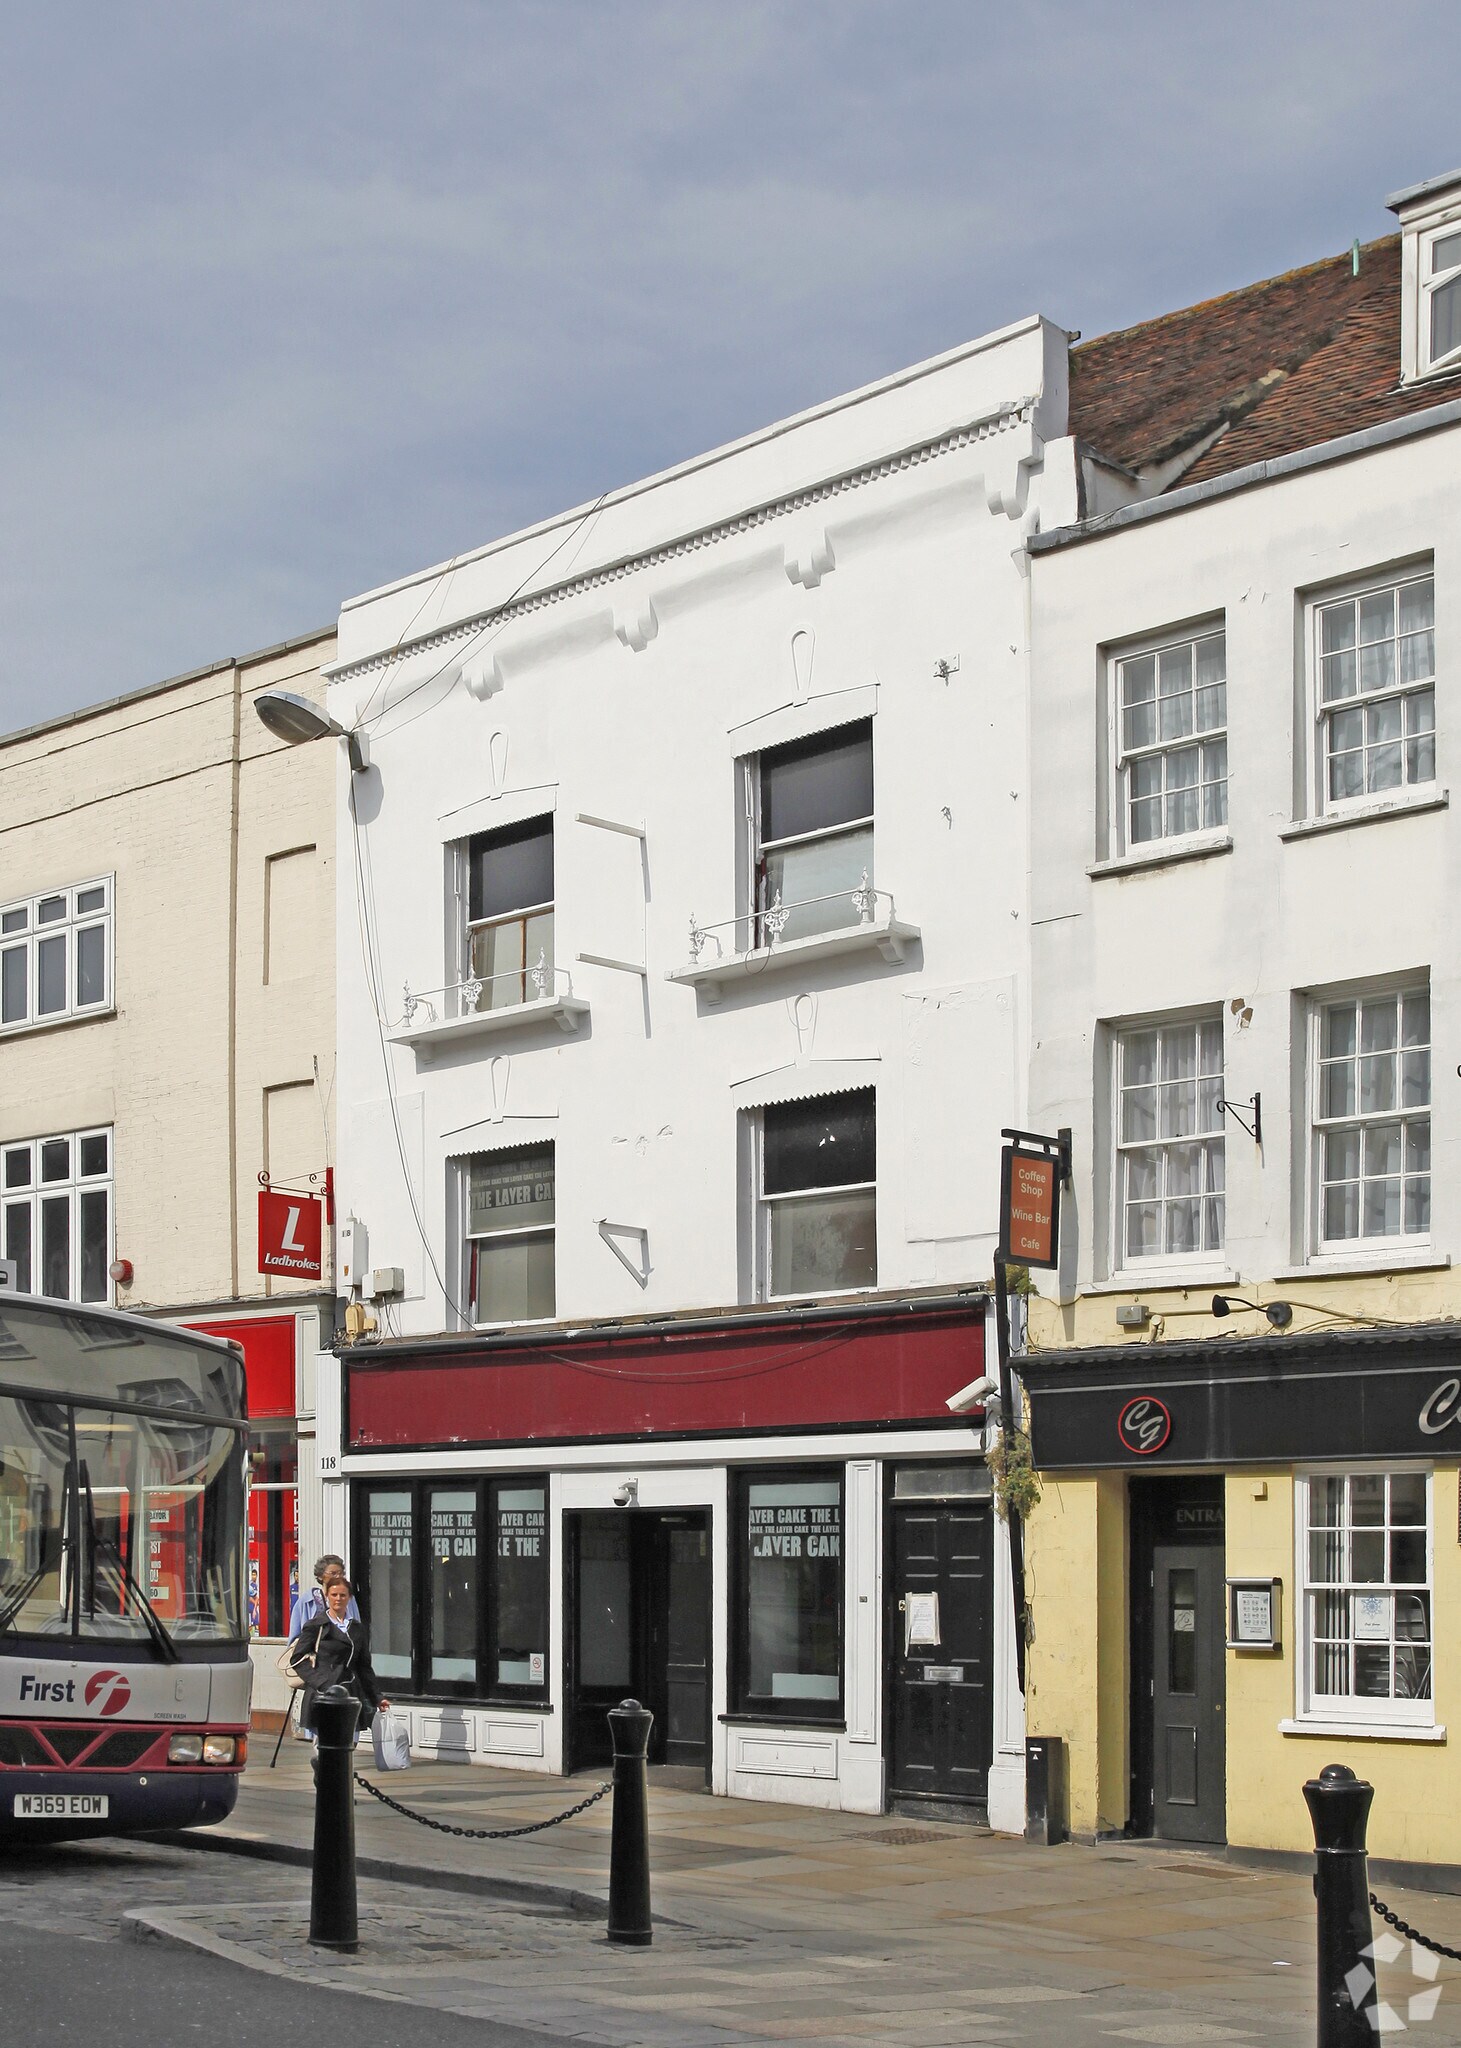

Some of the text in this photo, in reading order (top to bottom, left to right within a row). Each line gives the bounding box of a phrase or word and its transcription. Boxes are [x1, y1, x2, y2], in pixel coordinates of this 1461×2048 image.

[1018, 1168, 1046, 1183] Coffee
[470, 1190, 492, 1210] THE
[495, 1185, 531, 1207] LAYER
[1020, 1182, 1043, 1198] Shop
[1012, 1208, 1050, 1224] Wine Bar
[281, 1206, 305, 1252] L
[1021, 1236, 1040, 1250] Cafe
[264, 1253, 320, 1270] Ladbrokes
[321, 1456, 336, 1470] 118
[370, 1514, 412, 1527] THE LAYER
[432, 1514, 473, 1527] CAKE THE
[777, 1508, 806, 1523] CAKE
[810, 1508, 831, 1523] THE
[776, 1526, 793, 1534] LAYER
[794, 1526, 809, 1534] CAKE
[370, 1538, 412, 1556] THE LA
[515, 1537, 540, 1557] THE
[19, 1675, 75, 1702] First
[22, 1797, 102, 1814] W369 EOW
